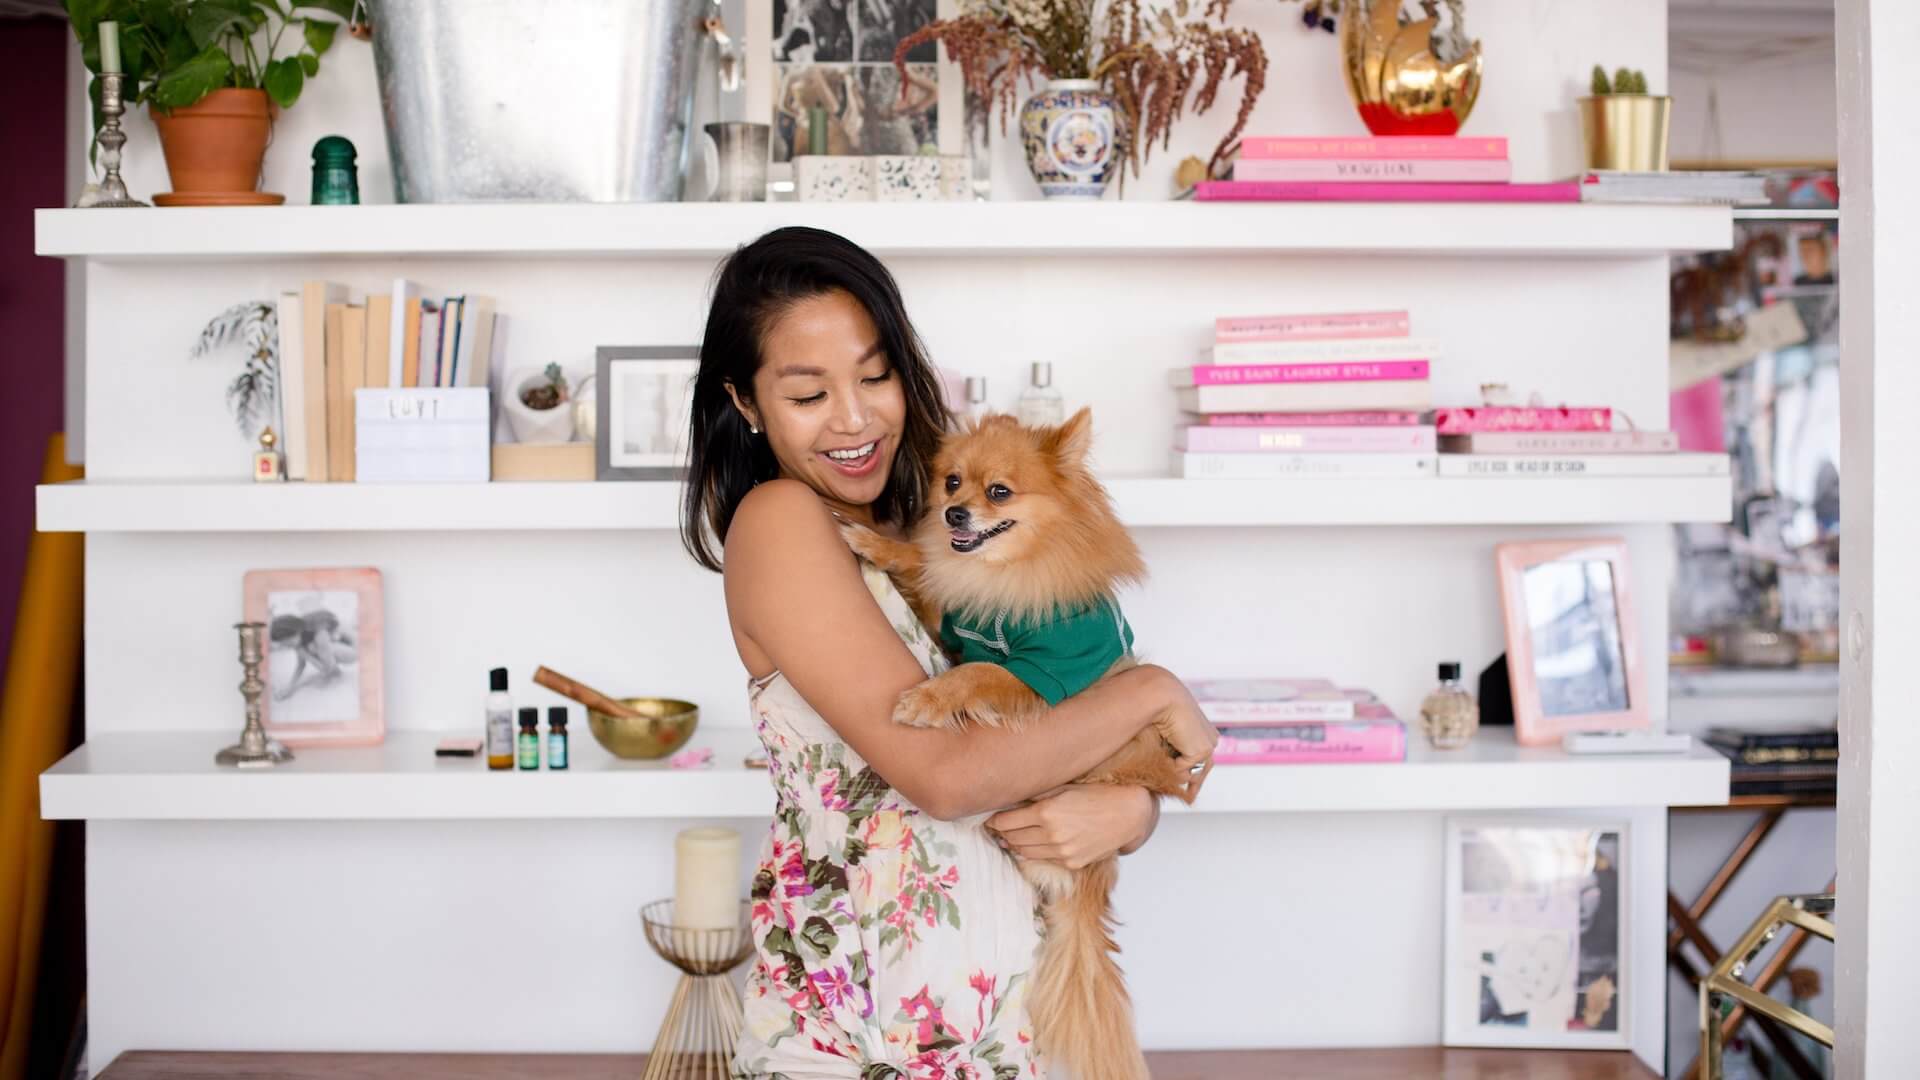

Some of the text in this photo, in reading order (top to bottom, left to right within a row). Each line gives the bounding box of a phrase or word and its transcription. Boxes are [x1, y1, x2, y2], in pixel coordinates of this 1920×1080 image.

[1208, 364, 1381, 381] YVES SAINT LAURENT STYLE
[1514, 460, 1537, 472] HEAD
[1539, 460, 1550, 472] OF
[1552, 460, 1586, 472] DESIGN
